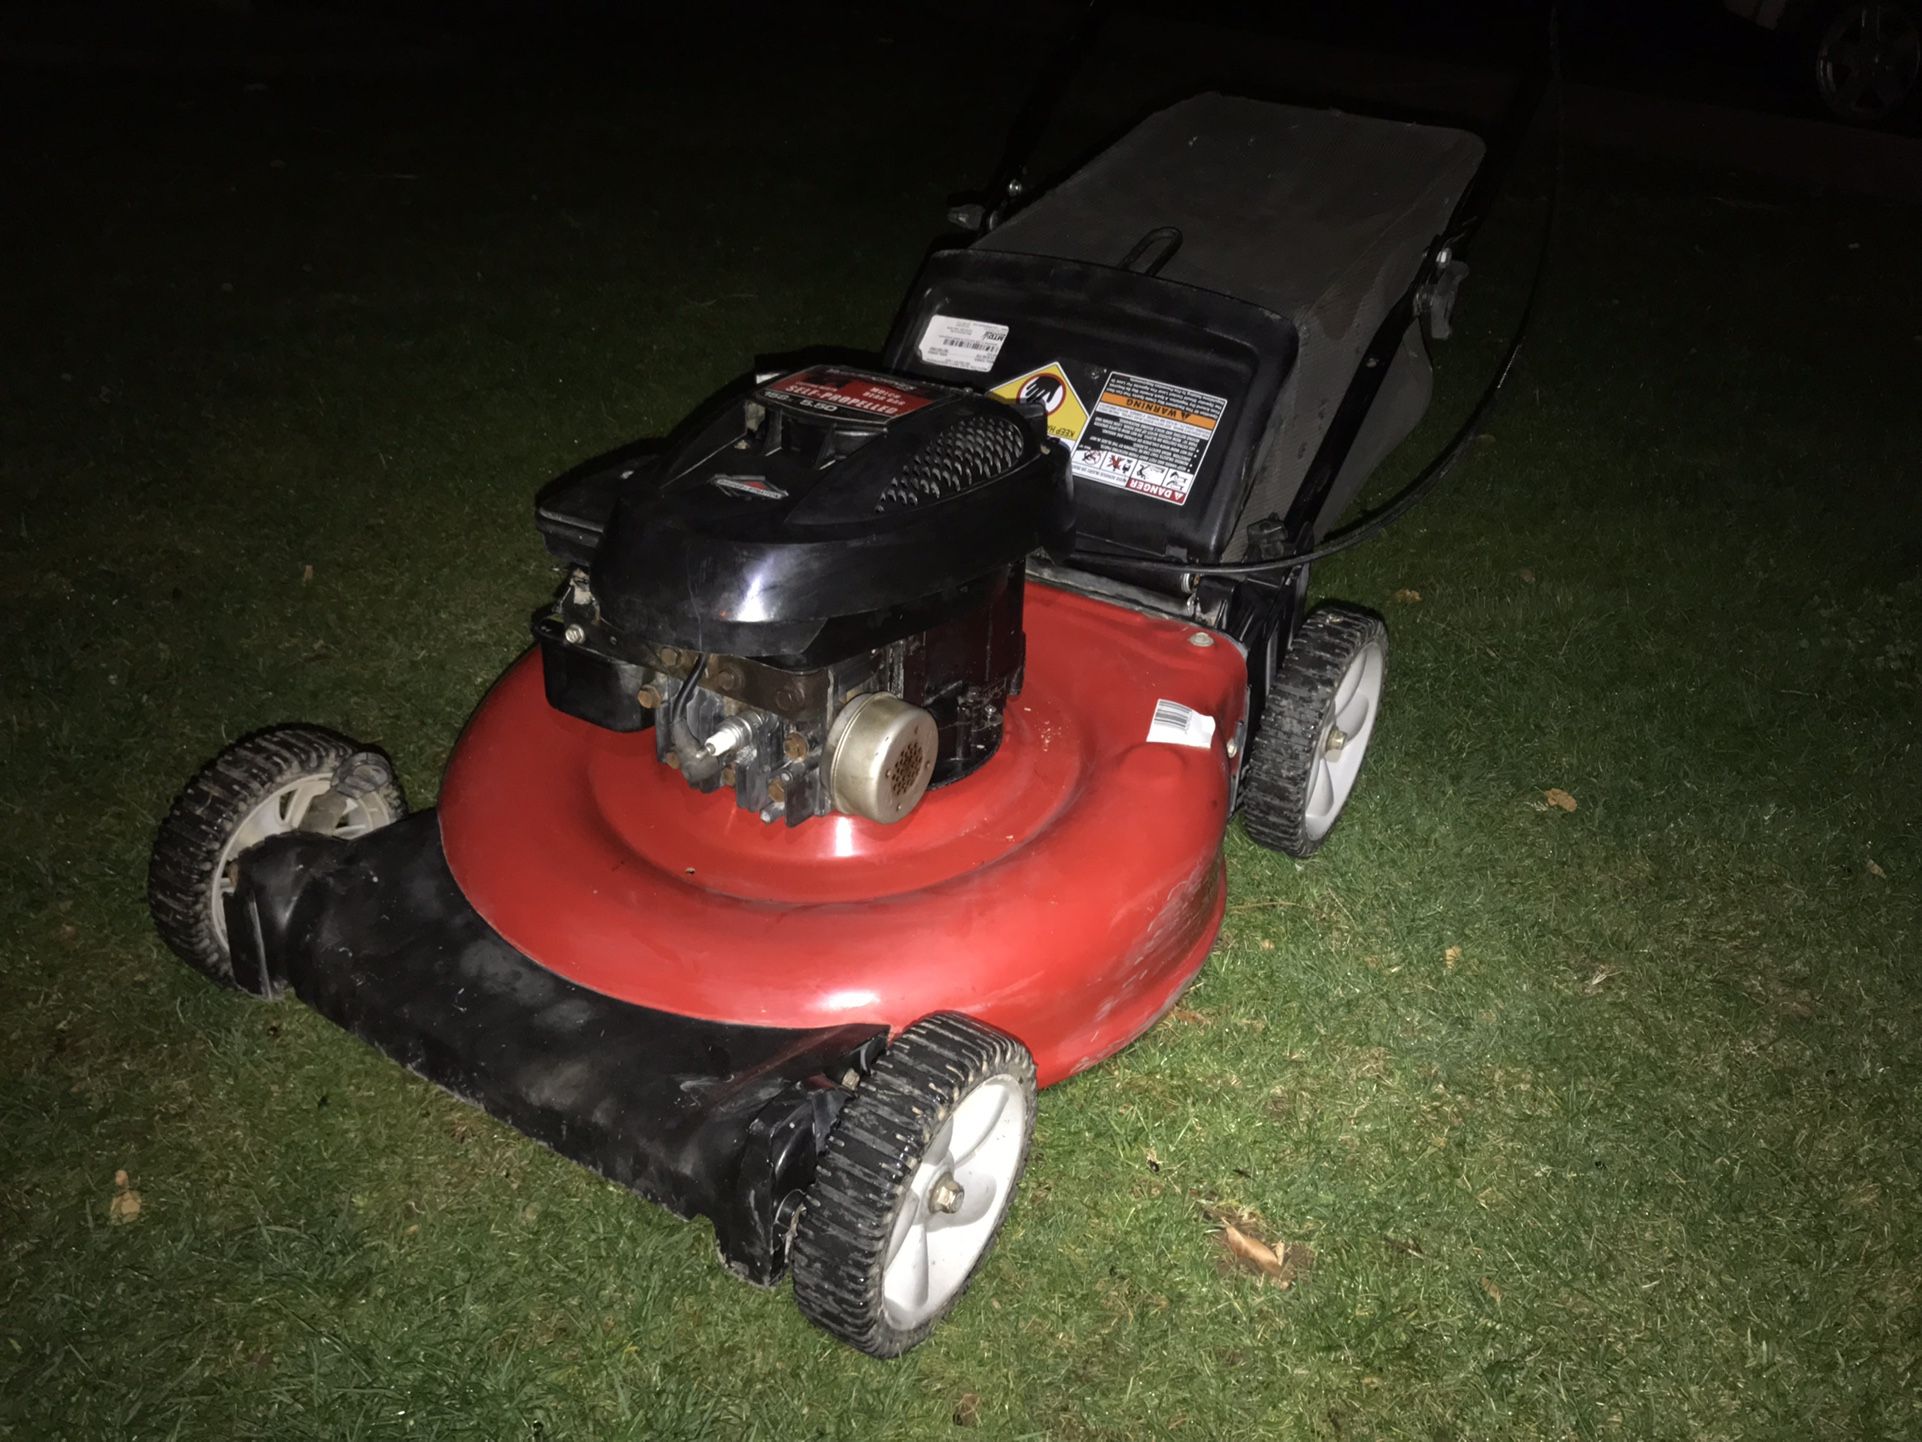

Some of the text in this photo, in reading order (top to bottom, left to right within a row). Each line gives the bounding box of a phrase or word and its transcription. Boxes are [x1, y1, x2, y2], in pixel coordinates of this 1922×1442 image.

[785, 385, 898, 414] SELF-PROPELLED
[1126, 398, 1177, 418] WARNING
[1056, 428, 1076, 437] KEEP
[1130, 479, 1172, 498] DANGER
